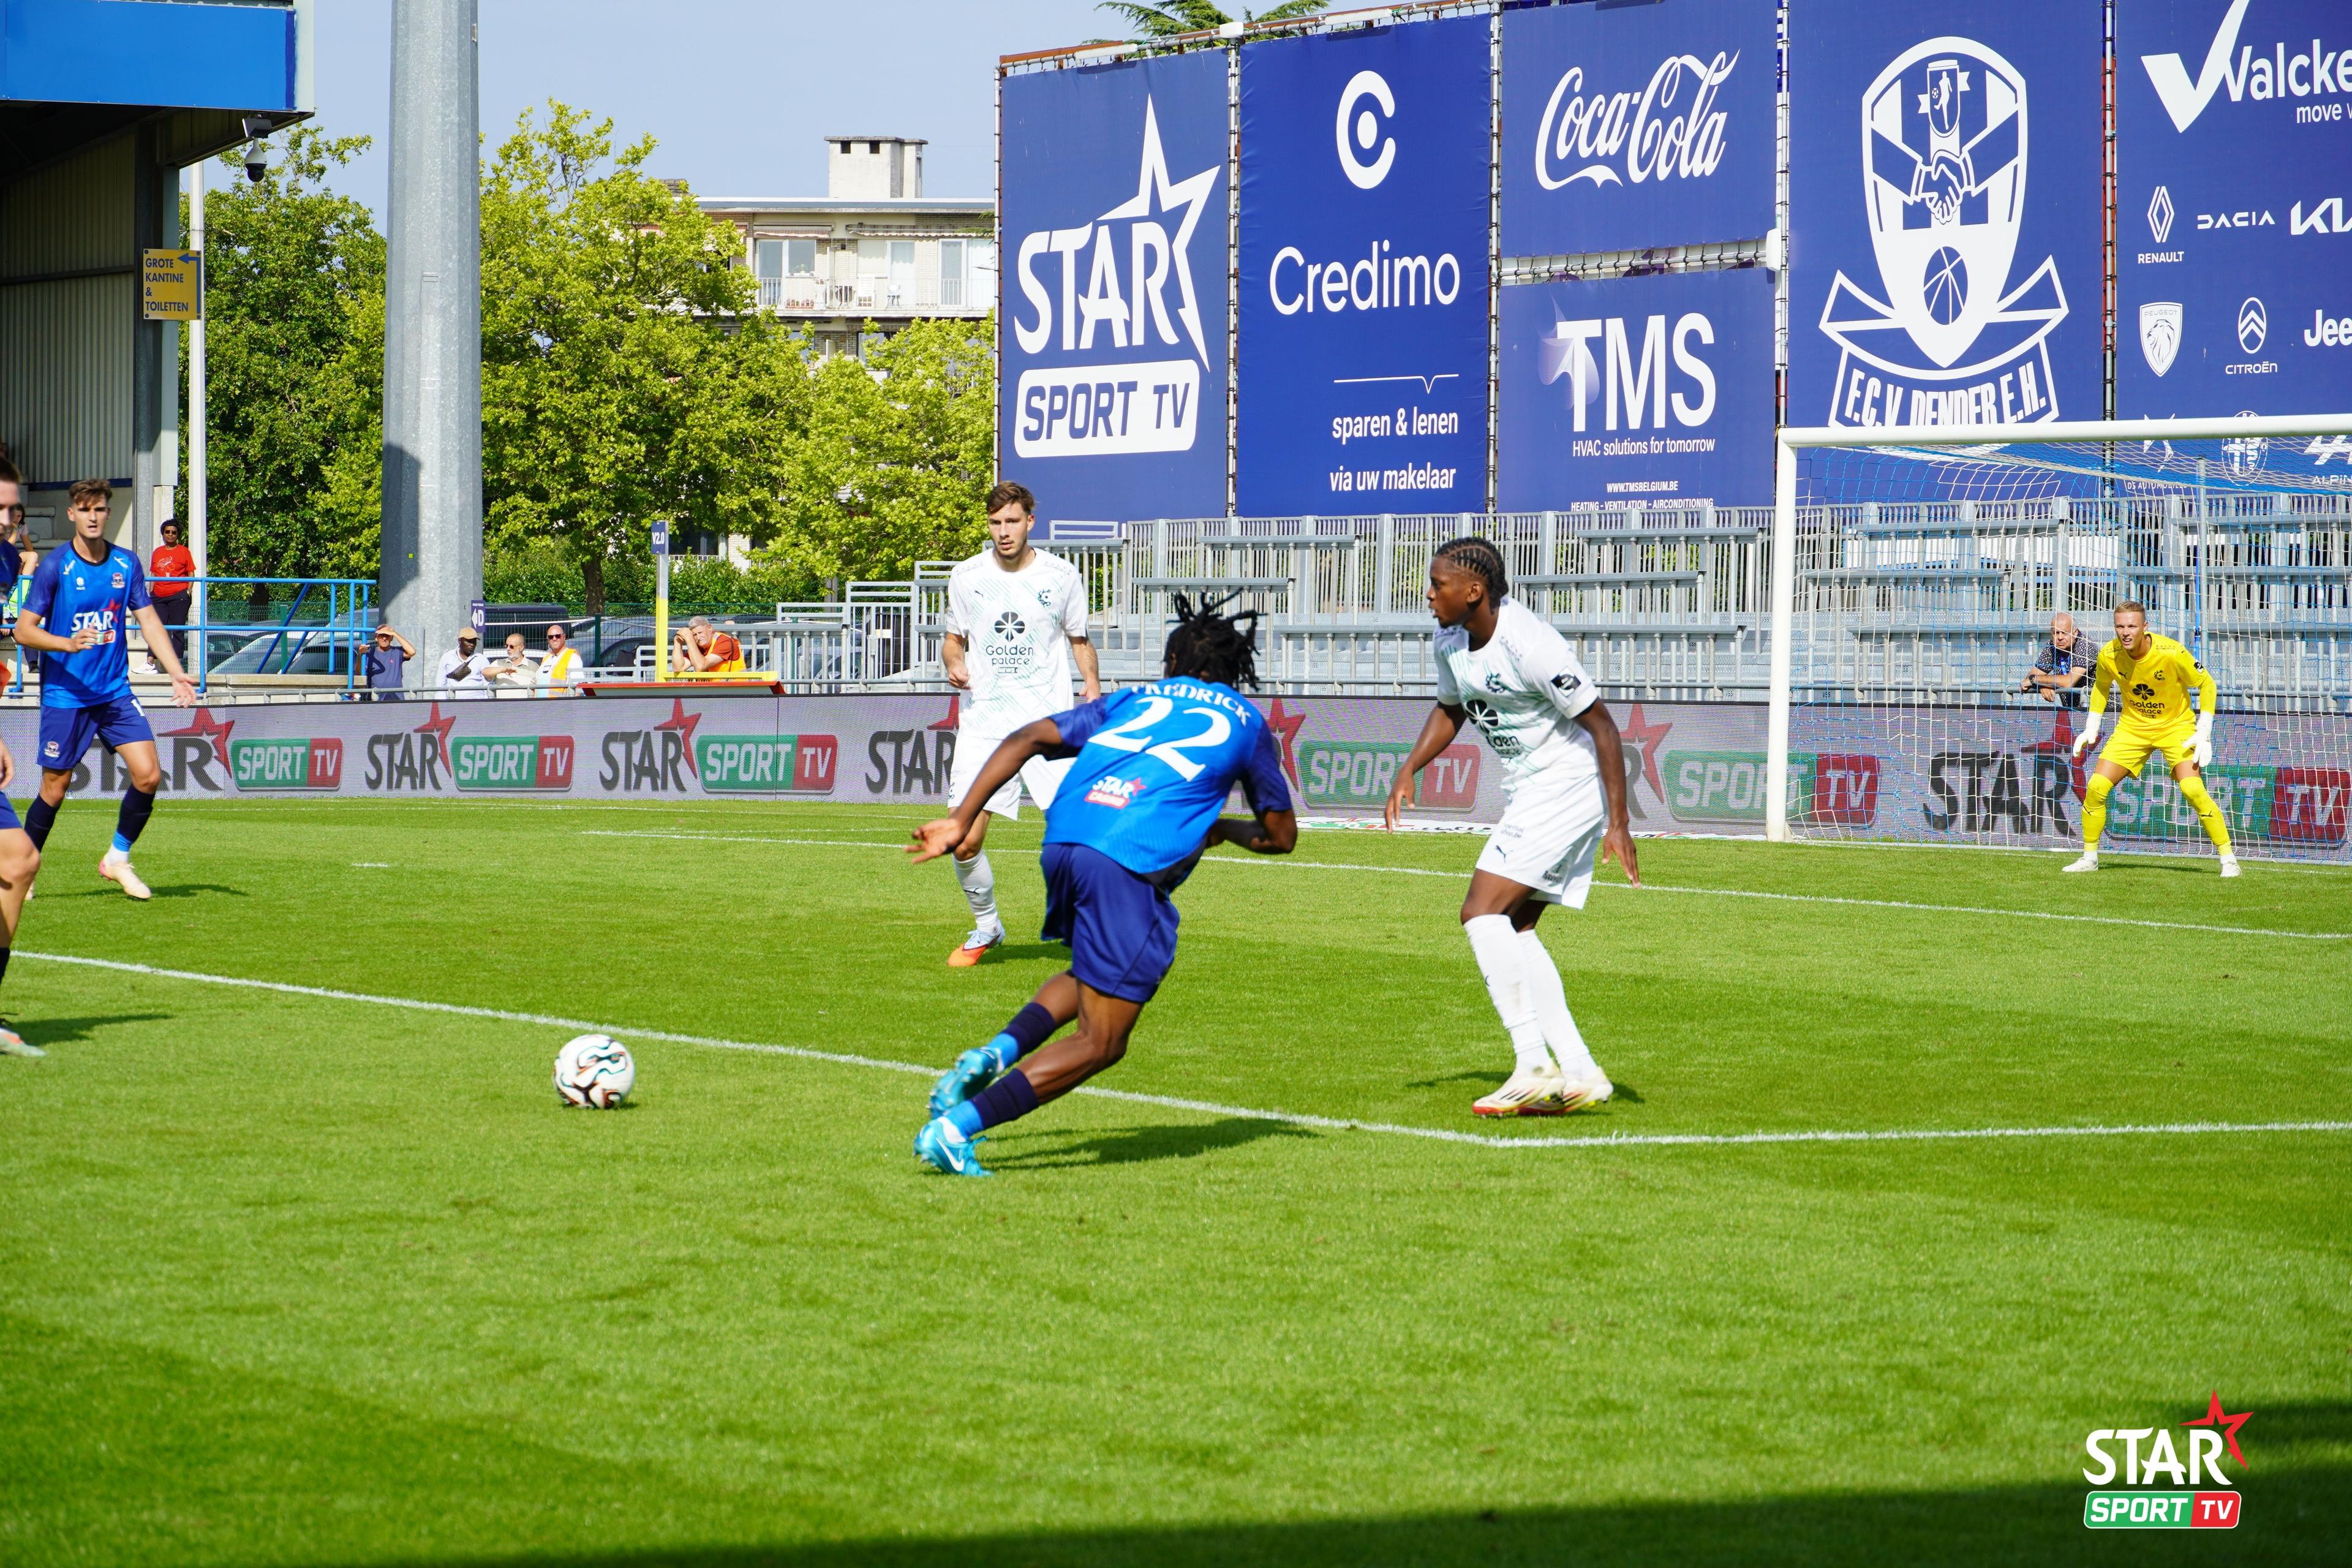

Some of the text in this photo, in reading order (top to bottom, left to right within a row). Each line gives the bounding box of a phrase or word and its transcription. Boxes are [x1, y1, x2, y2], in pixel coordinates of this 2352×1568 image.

[1535, 48, 1741, 190] Coca-Cola
[2297, 104, 2342, 123] move
[2197, 210, 2275, 230] DACIA
[146, 258, 173, 268] GROTE
[2138, 251, 2184, 264] RENAULT
[146, 273, 184, 282] KANTINE
[1014, 222, 1180, 354] STAR
[1270, 239, 1460, 315] Credimo
[146, 287, 152, 296] &
[146, 301, 188, 311] TOILETTEN
[1557, 312, 1716, 432] TMS
[1023, 381, 1190, 442] SPORT TV
[1909, 381, 1999, 427] DENDER
[1333, 407, 1458, 445] sparen & lenen
[1573, 437, 1715, 457] HVAC solutions for tomorrow
[1330, 463, 1456, 491] via uw makelaar
[1607, 481, 1678, 492] WWW.TMSBELGIUM.BE
[1571, 502, 1599, 511] HEATING
[1605, 500, 1647, 510] VENTILATION
[1653, 498, 1713, 509] AIRCONDITIONING
[652, 532, 665, 545] V2.0
[71, 611, 113, 631] STAR
[478, 609, 484, 626] D
[986, 644, 1034, 656] Golden
[992, 657, 1030, 666] palace
[1088, 696, 1231, 782] 22
[238, 746, 306, 781] SPORT
[314, 748, 339, 778] TV
[365, 732, 569, 790] STAR SPORT TV
[599, 729, 832, 793] STAR SPORT TV
[865, 729, 956, 794] STAR
[1092, 775, 1134, 798] STAR
[1434, 759, 1472, 793] TV
[1826, 770, 1871, 808] TV
[1923, 751, 2076, 837] STAR
[2288, 784, 2340, 826] TV
